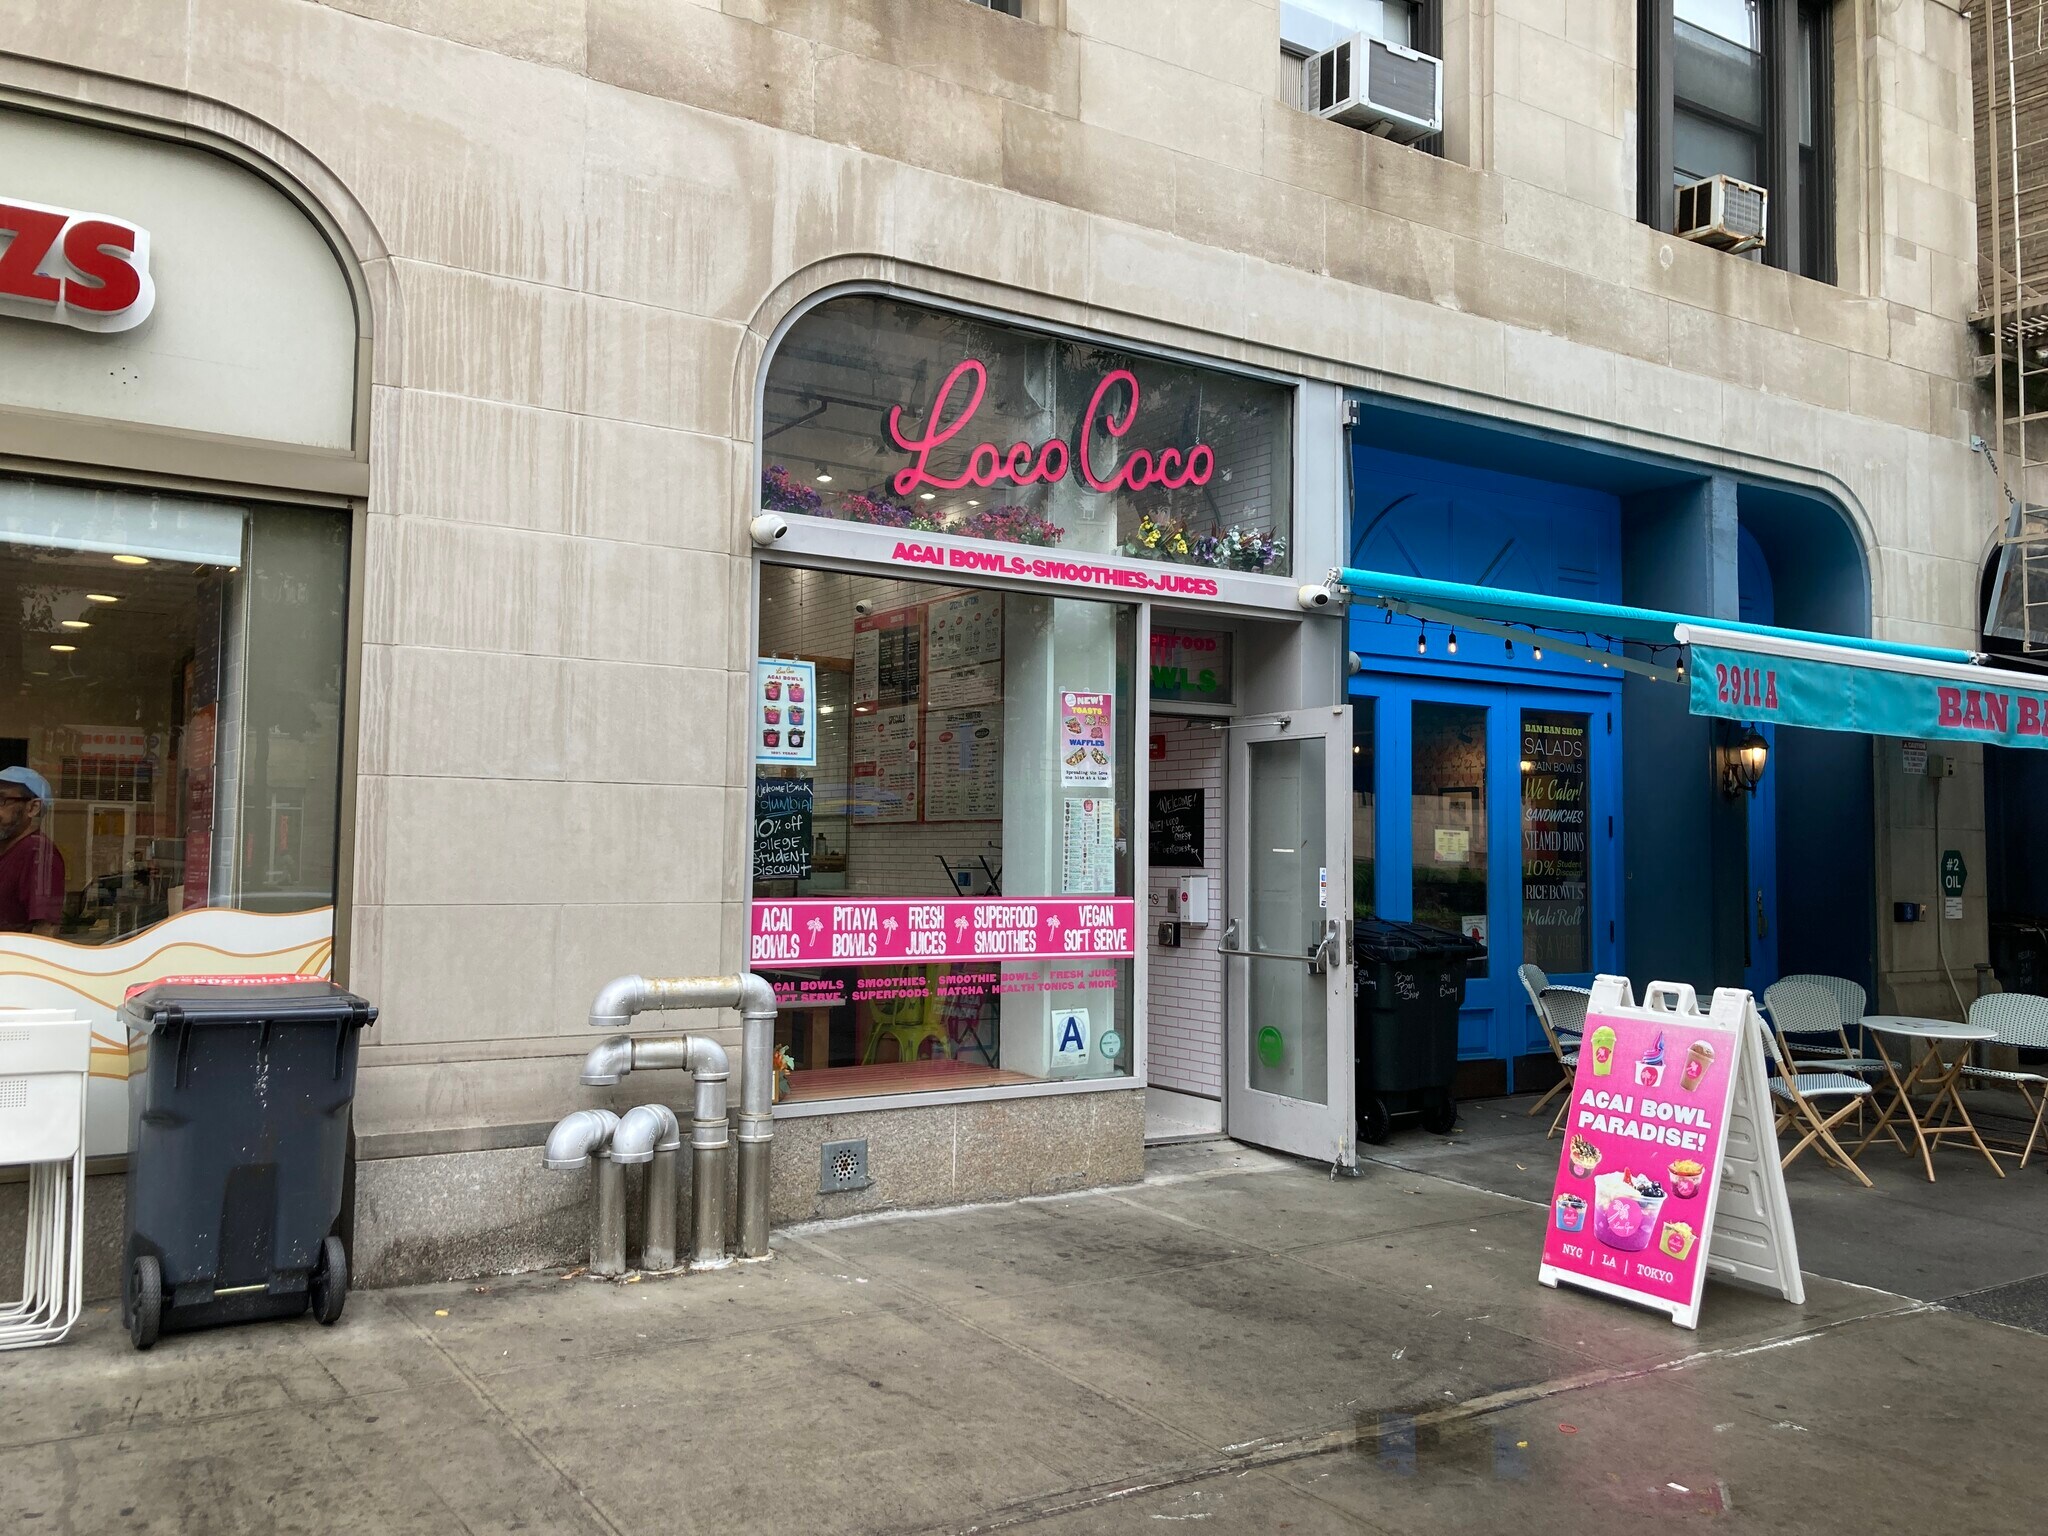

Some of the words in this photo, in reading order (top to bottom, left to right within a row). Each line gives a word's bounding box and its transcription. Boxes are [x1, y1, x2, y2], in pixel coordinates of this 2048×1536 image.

[889, 358, 1069, 495] Loco
[1080, 369, 1215, 492] Coco
[891, 542, 944, 566] ACAI
[1072, 707, 1102, 715] TOASTS
[1077, 695, 1104, 706] NEW!
[1937, 686, 2009, 732] BAN
[1525, 724, 1543, 734] BAN
[1543, 725, 1561, 735] BAN
[1561, 727, 1583, 736] SHOP
[1069, 739, 1105, 747] WAFFLES
[1524, 737, 1583, 758] SALADS
[1529, 761, 1552, 771] RAIN
[1554, 762, 1583, 774] BOWLS
[1525, 778, 1543, 800] We
[1547, 778, 1583, 801] Cater!
[754, 818, 781, 838] 10%
[784, 814, 803, 831] off
[1525, 808, 1584, 824] SANDWICHES
[1524, 830, 1560, 851] STEAMED
[1563, 831, 1585, 852] BUNS
[1526, 859, 1555, 876] 10%
[1555, 868, 1583, 876] Discount
[1557, 860, 1582, 868] Student
[1946, 858, 1959, 871] #2
[1525, 884, 1548, 900] RICE
[1549, 884, 1584, 900] BOWLS
[1945, 875, 1961, 889] OIL
[761, 907, 793, 932] ACAI
[833, 906, 878, 931] PITAYA
[908, 905, 945, 930] FRESH
[973, 905, 1038, 929] SUPERFOOD
[1078, 904, 1114, 927] VEGAN
[1526, 906, 1556, 926] Maki
[1557, 905, 1585, 926] Roll
[752, 933, 800, 959] BOWLS
[832, 932, 877, 957] BOWLS
[905, 931, 947, 955] JUICES
[974, 929, 1037, 954] SMOOTHIES
[1064, 928, 1090, 951] SOFT
[1093, 928, 1127, 951] SERVE
[770, 981, 795, 991] CAI
[800, 979, 844, 991] BOWLS
[857, 976, 926, 988] SMOOTHIES
[938, 973, 997, 985] SMOOTHIE
[1001, 971, 1039, 982] BOWLS
[1050, 970, 1083, 979] FRESH
[1088, 968, 1117, 978] JUICE
[775, 993, 798, 1003] OFT
[800, 991, 841, 1002] SERVE
[852, 988, 930, 1001] SUPERFOODS
[937, 986, 983, 997] MATCHA
[992, 983, 1035, 995] HEALTH
[1037, 981, 1075, 991] TONICS
[1077, 981, 1086, 990] &
[1088, 979, 1118, 989] MORE
[1059, 1016, 1084, 1052] A
[1579, 1088, 1634, 1114] ACAI
[1640, 1098, 1712, 1129] BOWL
[1578, 1110, 1707, 1152] PARADISE!
[1562, 1243, 1583, 1258] NYC
[1601, 1253, 1617, 1268] LA
[1636, 1263, 1673, 1283] TOKYO
